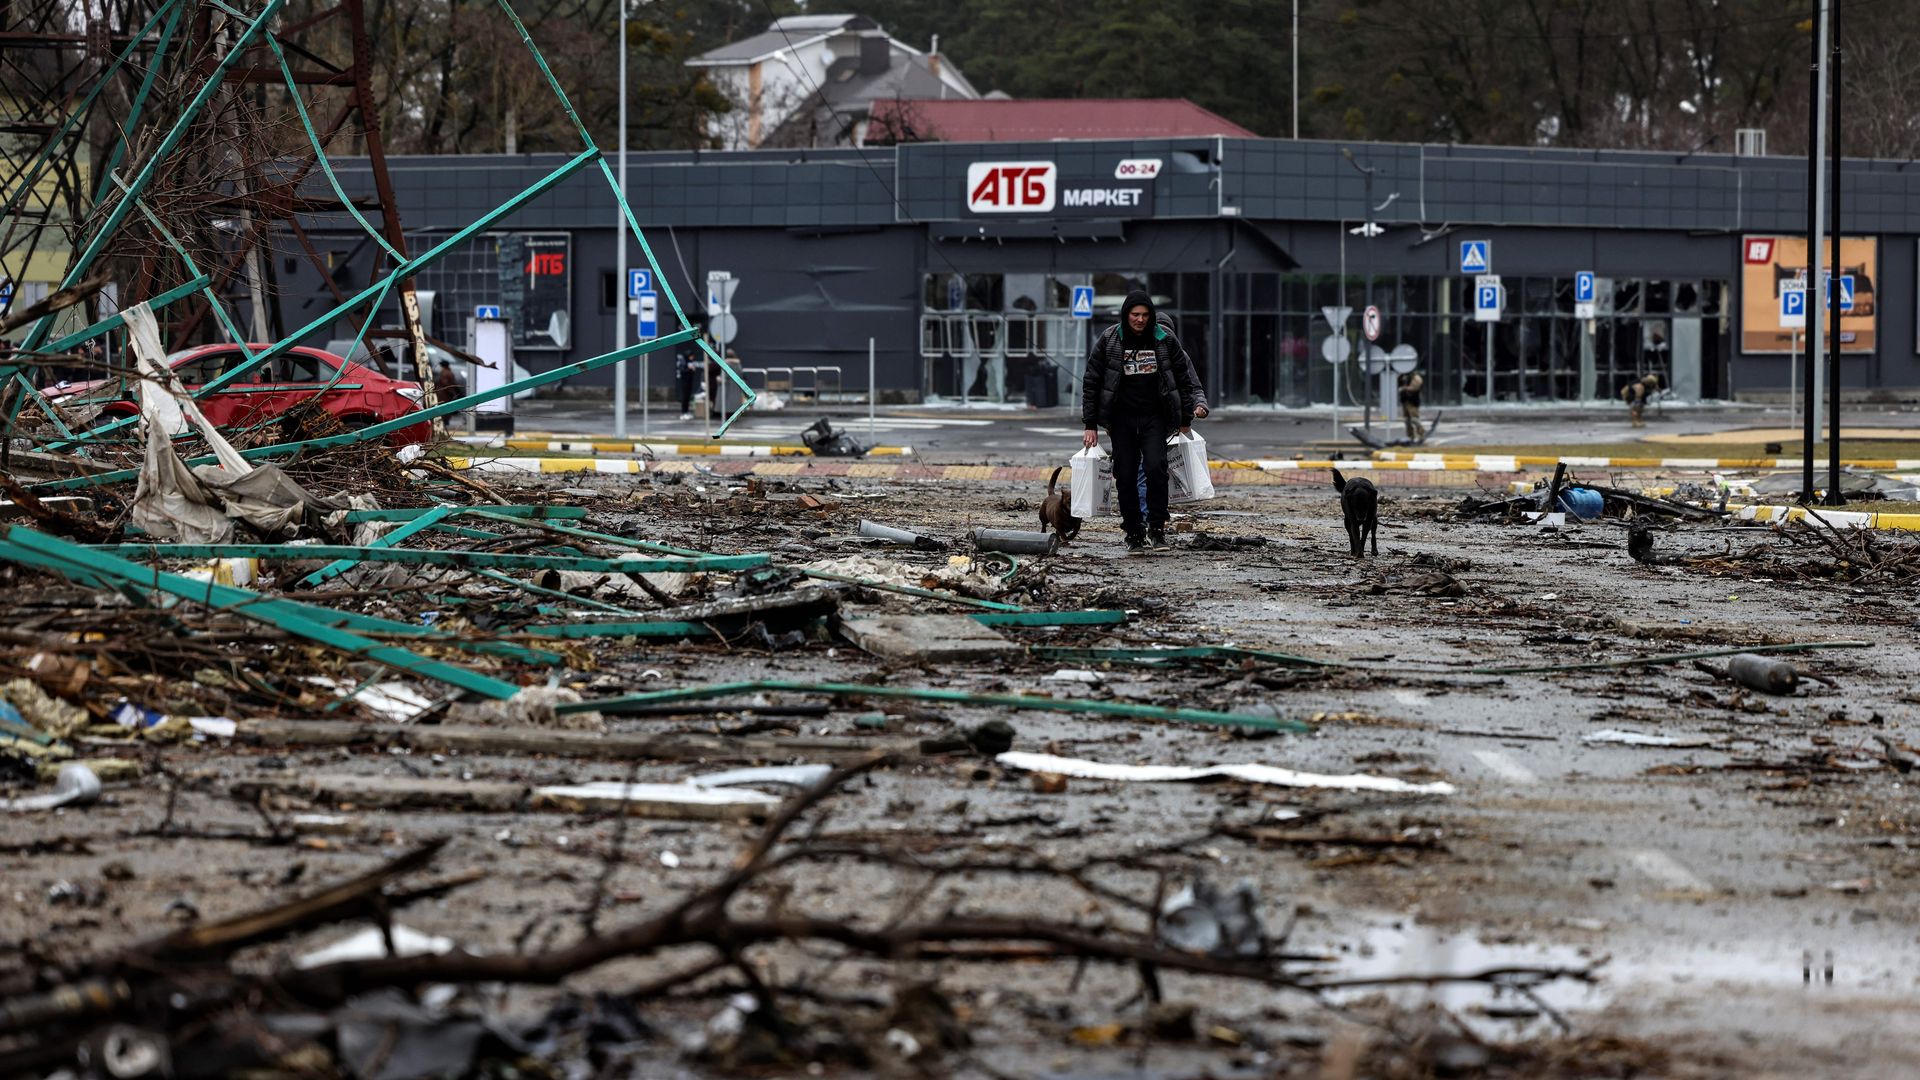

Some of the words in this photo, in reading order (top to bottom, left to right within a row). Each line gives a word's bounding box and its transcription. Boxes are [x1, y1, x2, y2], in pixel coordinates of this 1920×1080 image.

[1119, 163, 1156, 175] 00-24
[972, 167, 1050, 206] АТБ
[1063, 188, 1143, 207] МАРКЕТ
[525, 254, 564, 274] АТБ
[1580, 275, 1590, 299] P
[1482, 288, 1494, 307] P
[1788, 294, 1801, 314] P
